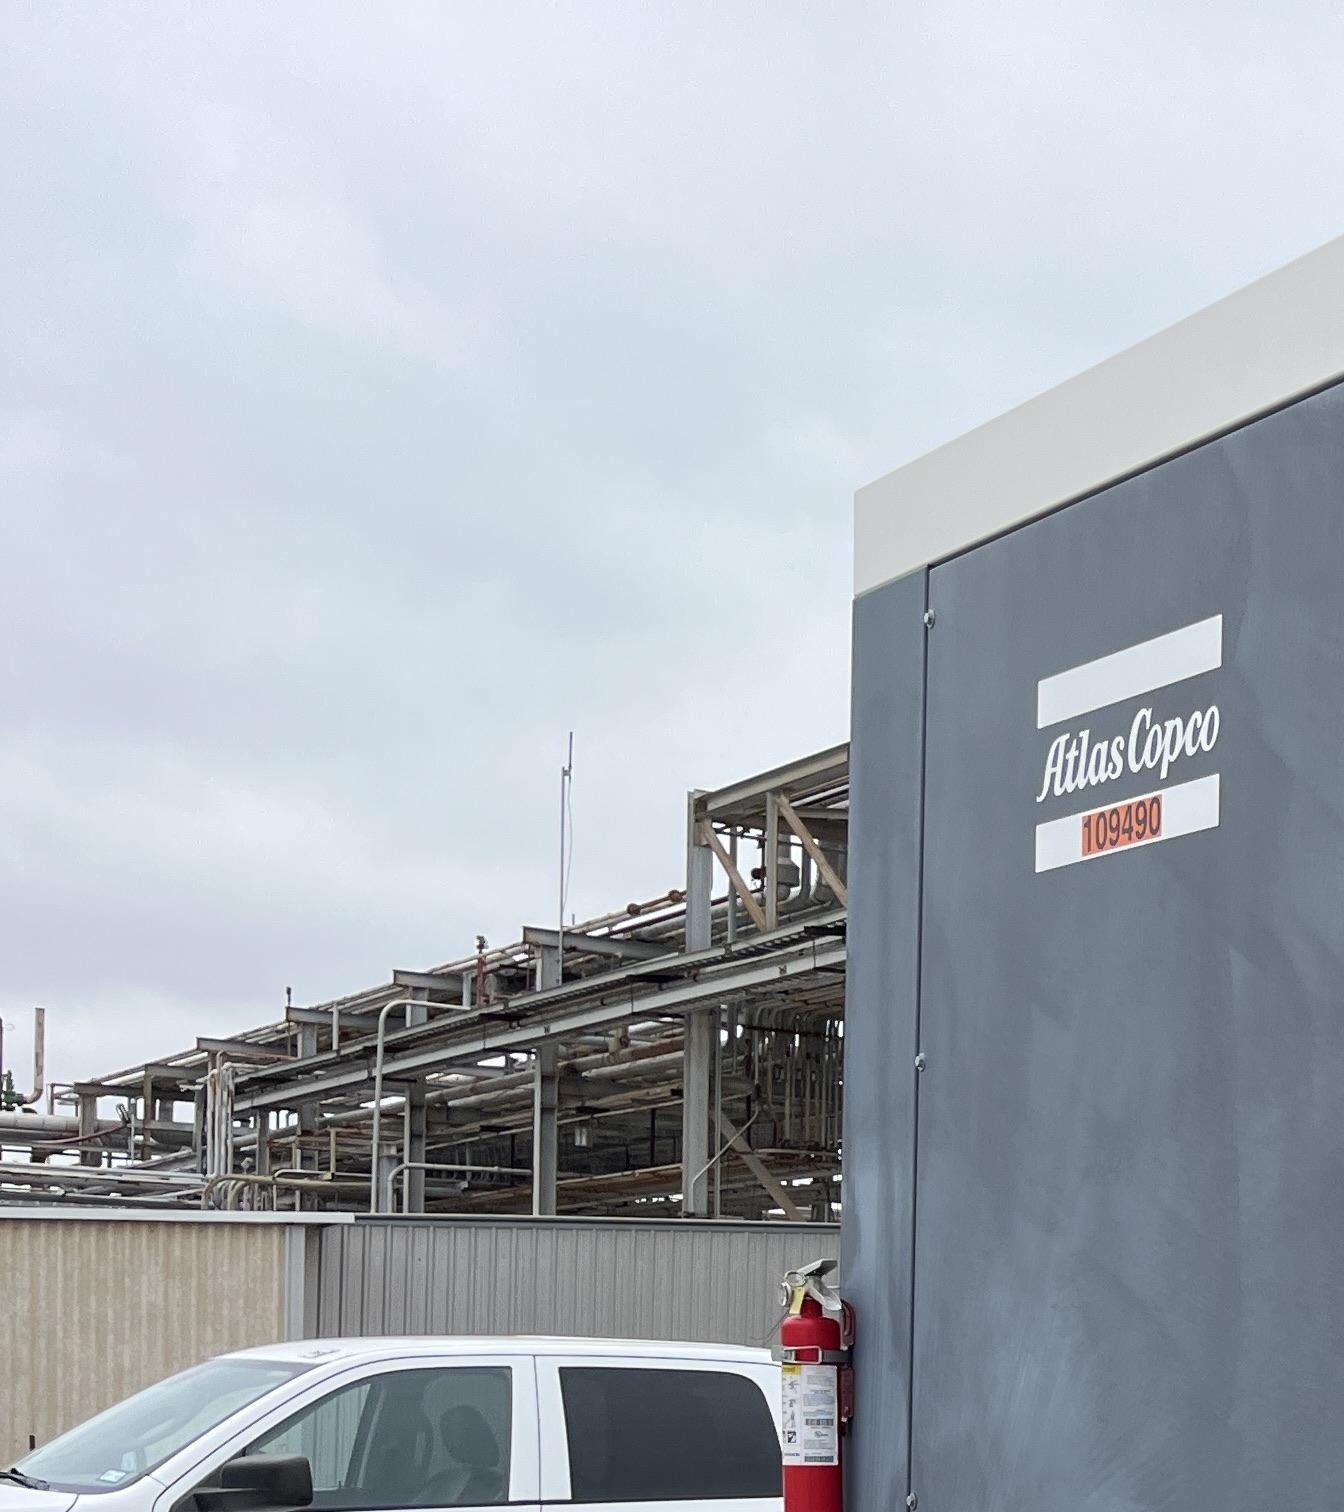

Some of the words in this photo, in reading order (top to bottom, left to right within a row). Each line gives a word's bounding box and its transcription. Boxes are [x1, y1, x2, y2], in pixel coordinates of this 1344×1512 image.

[1036, 729, 1125, 802] Atlas
[1128, 705, 1220, 779] Copco
[1083, 797, 1163, 852] 109490
